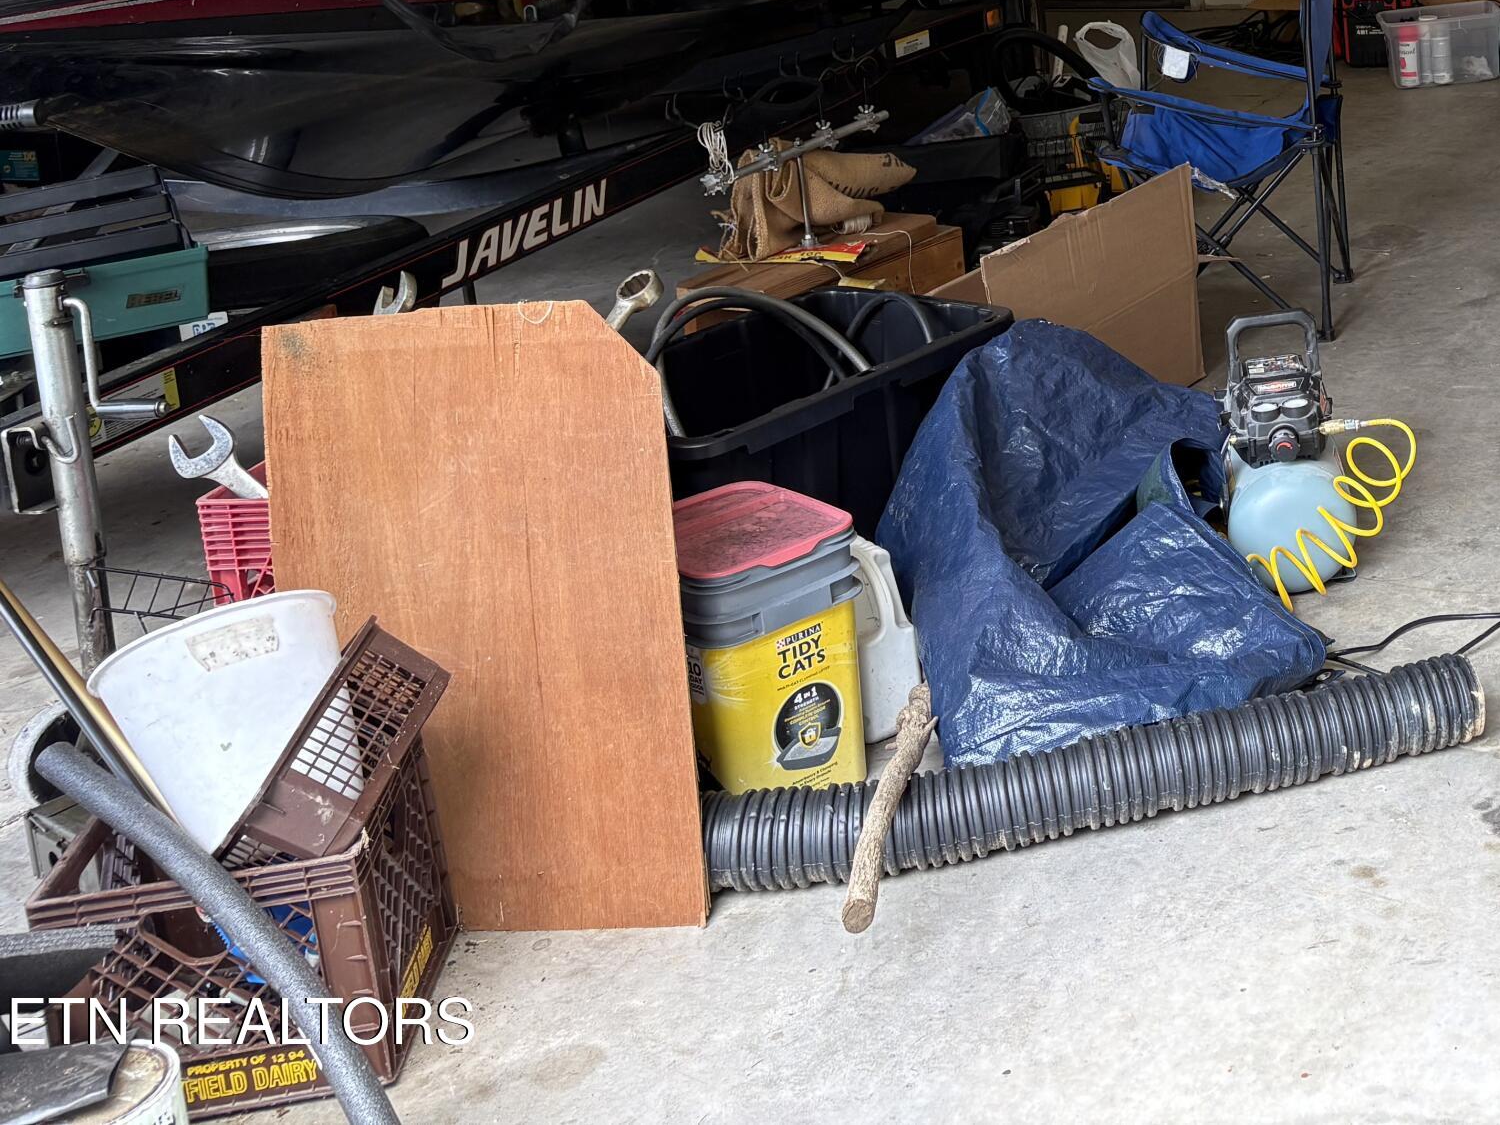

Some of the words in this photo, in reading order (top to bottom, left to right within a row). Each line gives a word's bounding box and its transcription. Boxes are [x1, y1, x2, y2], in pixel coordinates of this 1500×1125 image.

[441, 178, 608, 290] JAVELIN
[777, 634, 822, 664] TIDY
[785, 623, 822, 646] PURINA
[778, 648, 826, 680] CATS
[794, 693, 803, 704] 4
[811, 686, 818, 697] 1
[187, 1056, 249, 1077] PROPERTY
[250, 1053, 267, 1065] OF
[271, 1053, 286, 1063] 12
[287, 1050, 306, 1061] 94
[183, 1070, 248, 1104] FIELD
[251, 1058, 318, 1092] DAIRY
